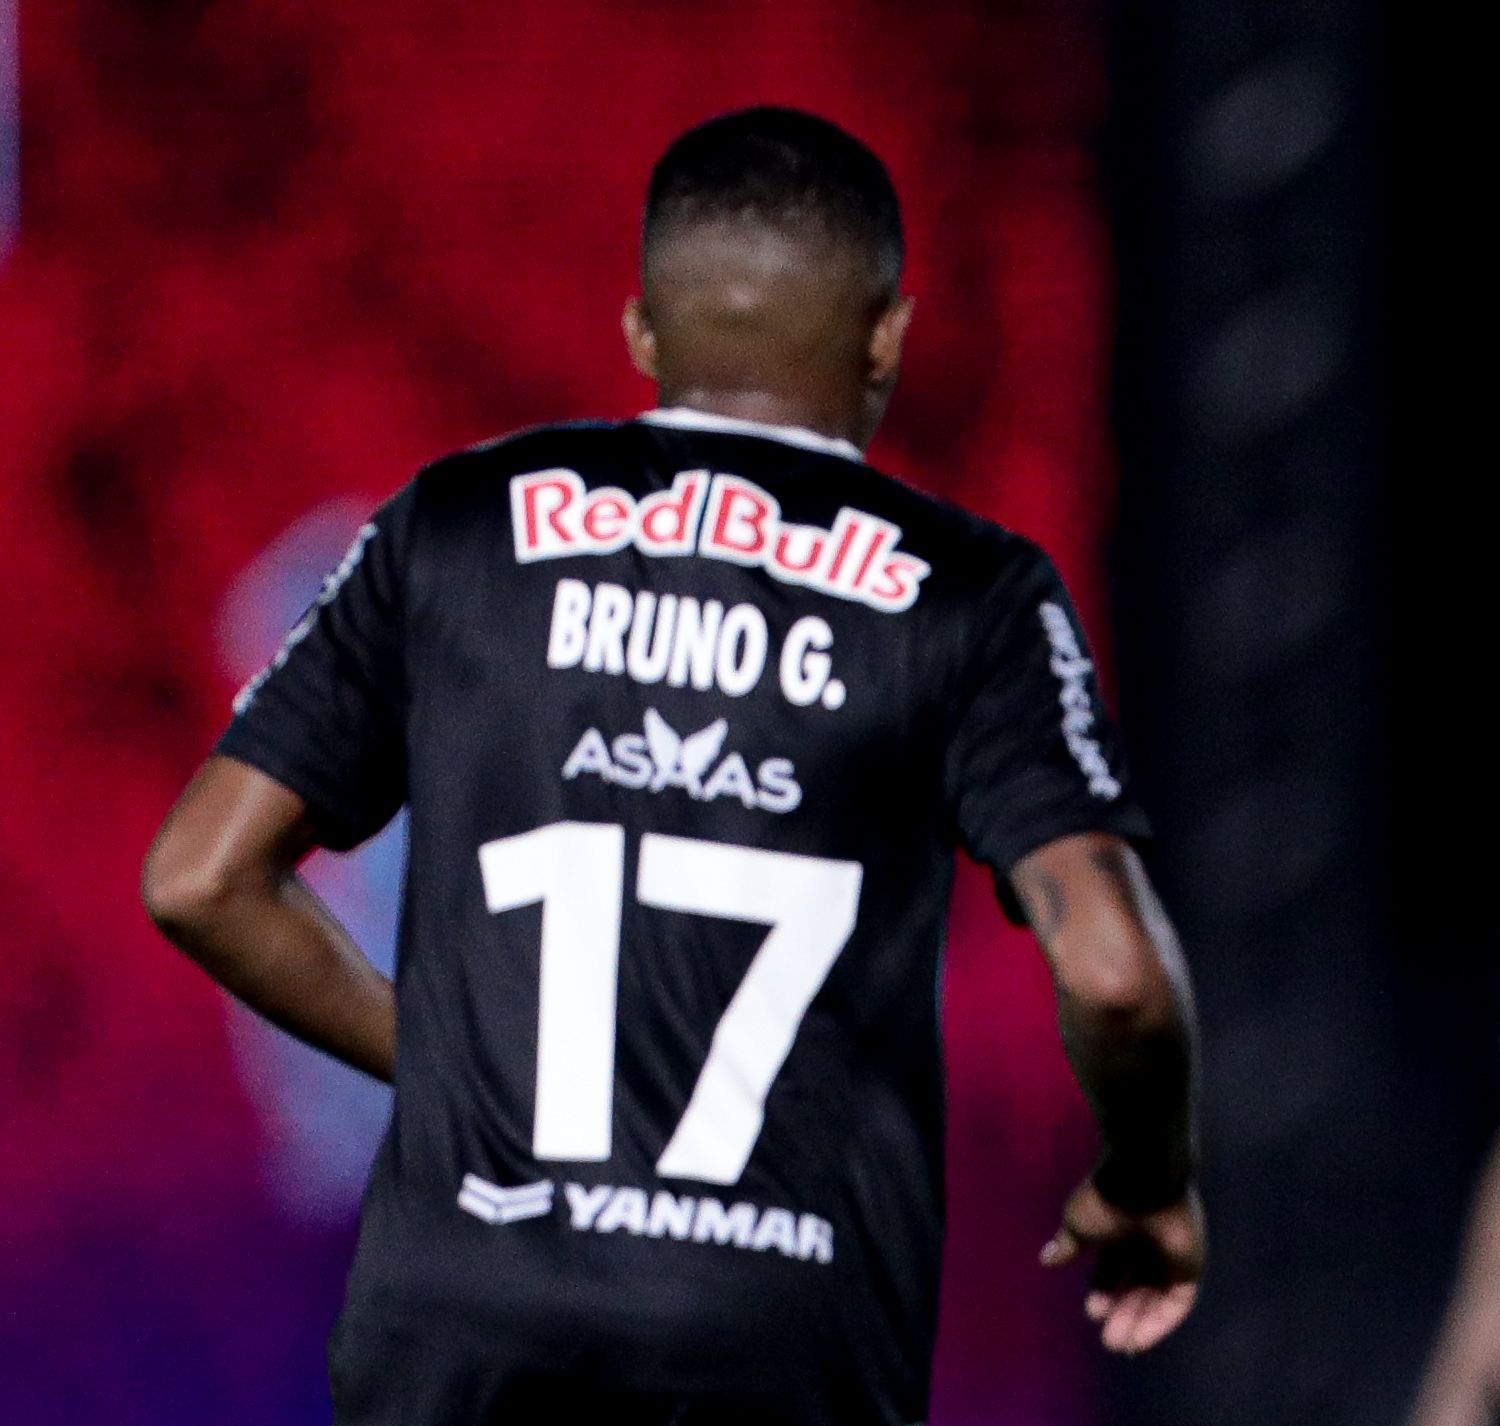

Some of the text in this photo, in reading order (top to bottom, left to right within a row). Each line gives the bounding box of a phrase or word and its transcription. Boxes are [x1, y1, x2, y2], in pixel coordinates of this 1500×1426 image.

[515, 473, 926, 608] Red Bulls
[546, 577, 847, 710] BRUNO G.
[478, 820, 862, 1185] 17
[564, 1181, 835, 1265] YANMAR
